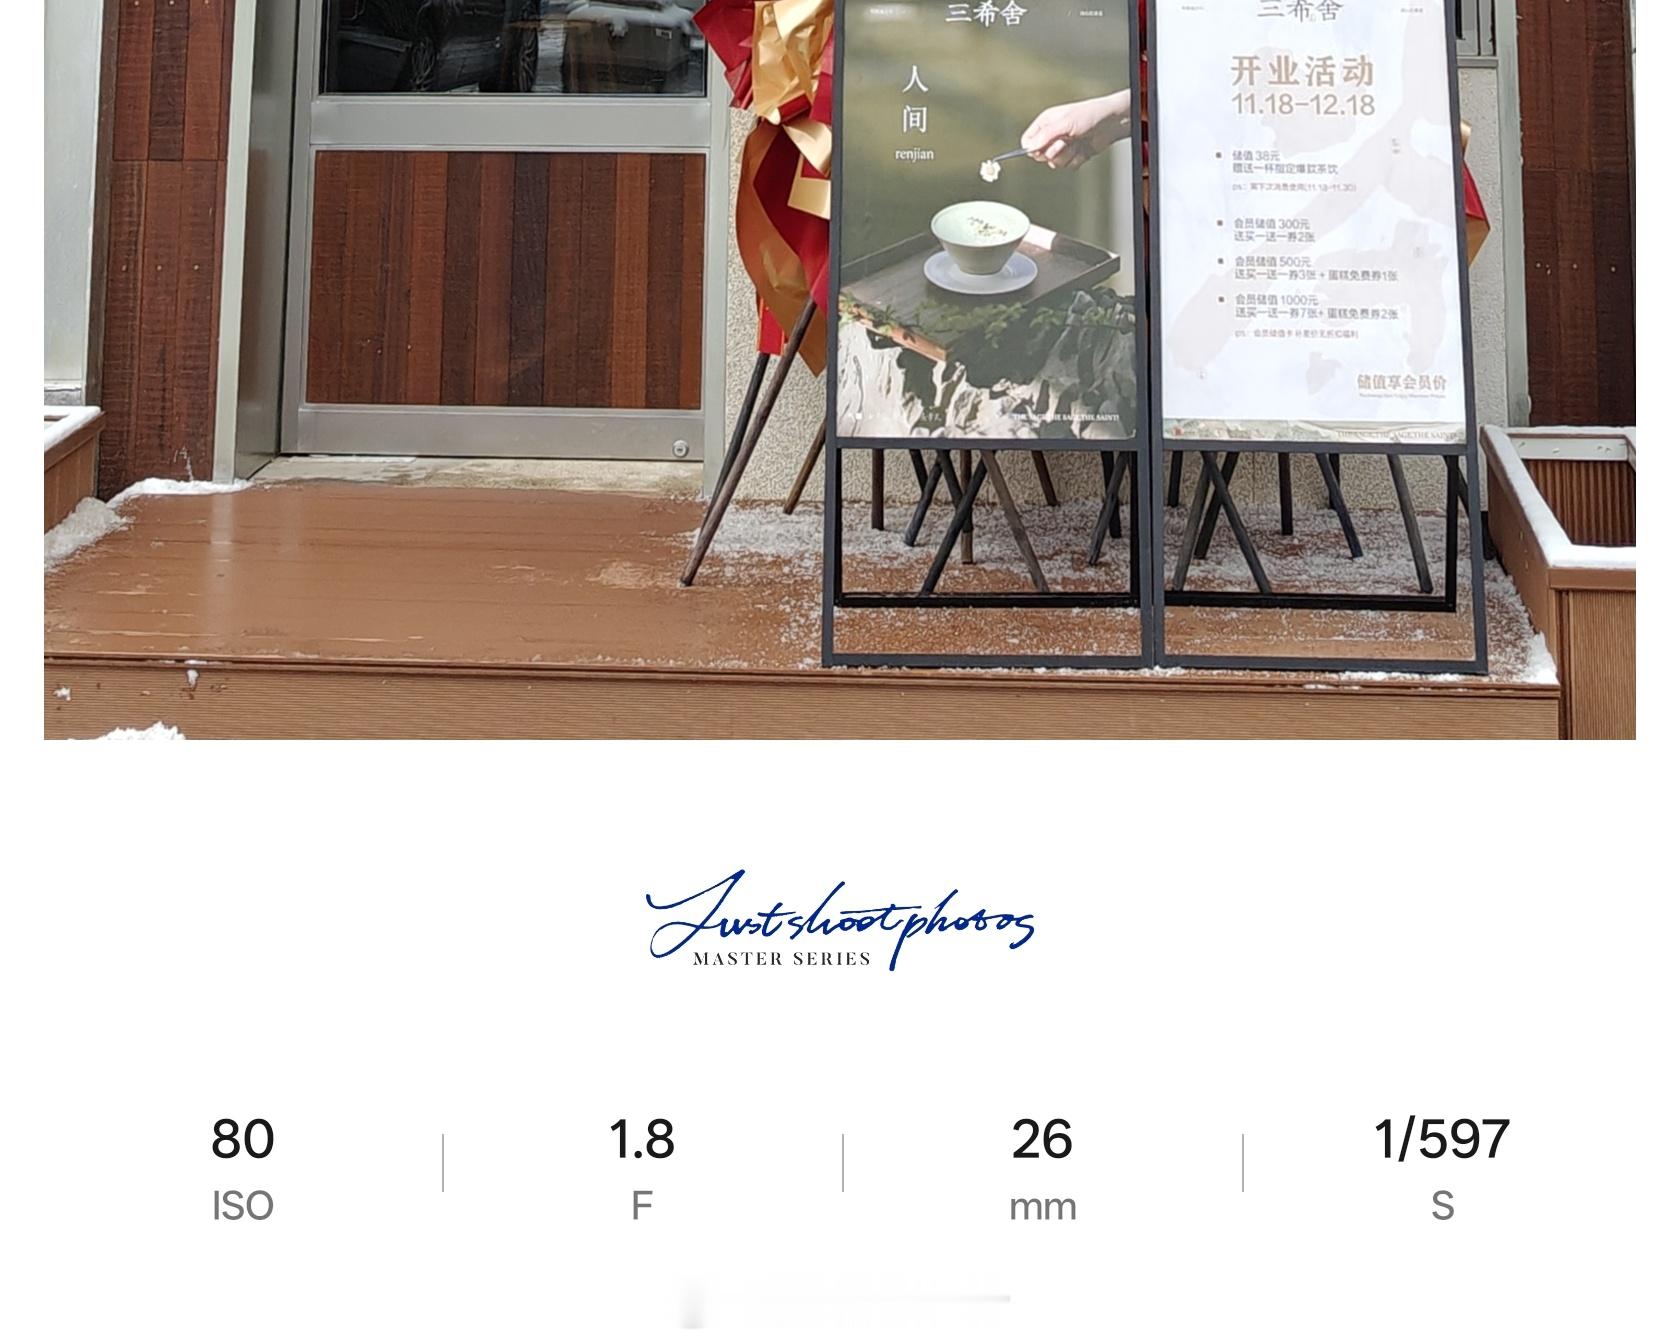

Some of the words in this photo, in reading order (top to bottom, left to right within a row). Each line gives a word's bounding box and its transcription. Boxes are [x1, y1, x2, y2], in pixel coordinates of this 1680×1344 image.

[945, 0, 1027, 27] 三希舍
[1230, 55, 1374, 87] 开业活动
[902, 64, 929, 133] 人间
[1231, 93, 1375, 116] 11.18-12.18
[895, 147, 934, 162] renjian
[1357, 374, 1447, 391] 储值享会员价
